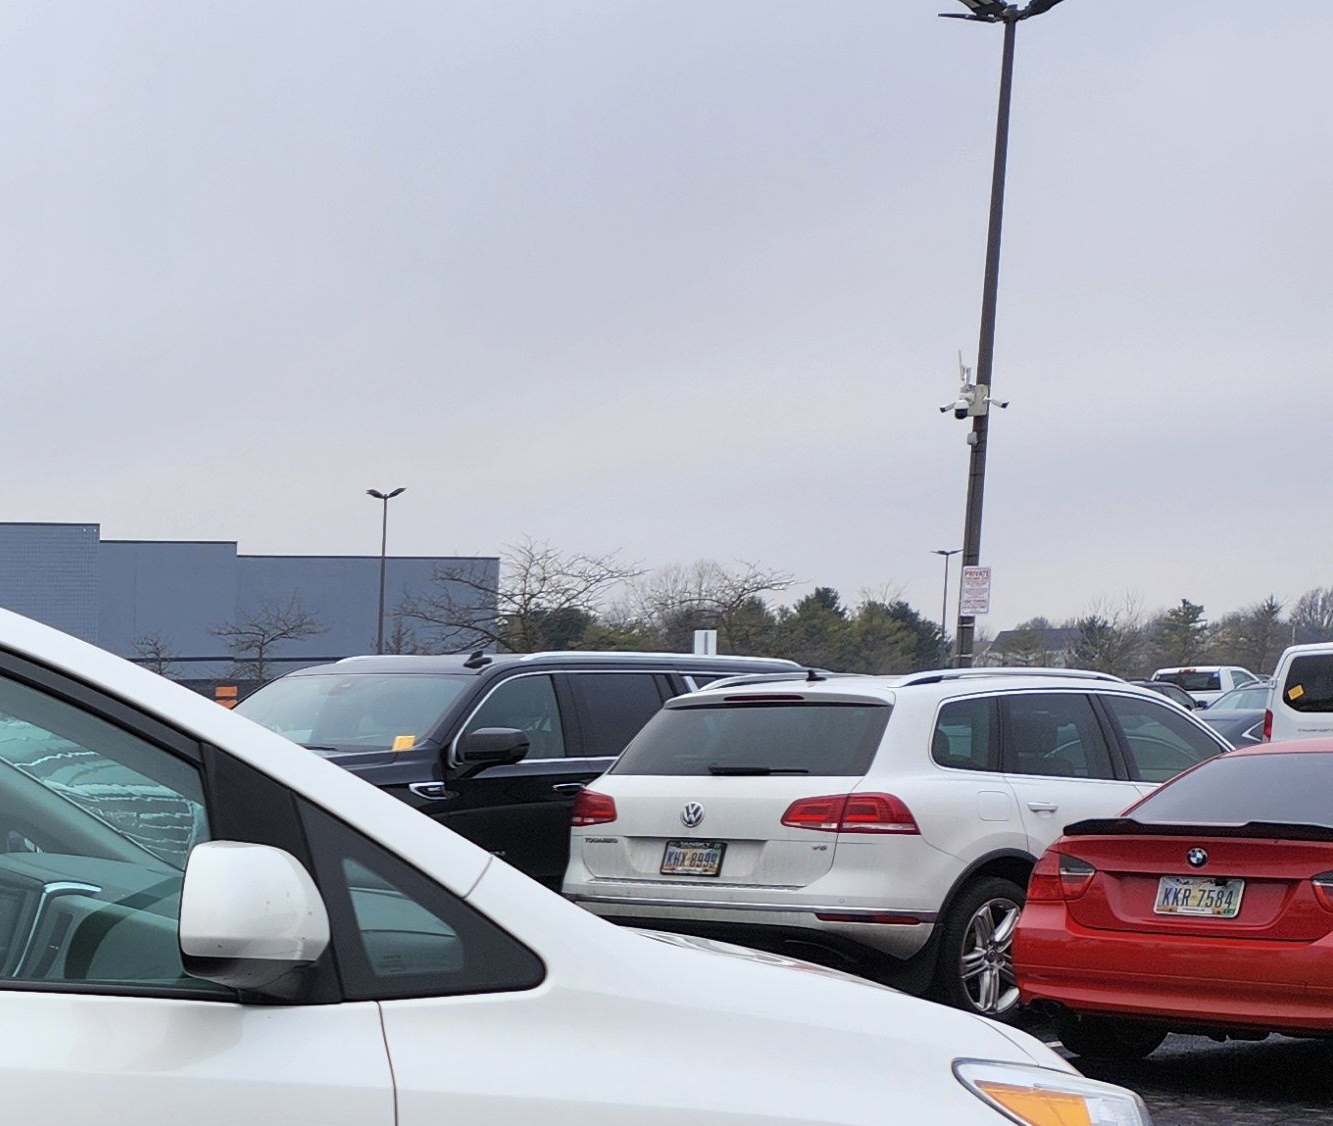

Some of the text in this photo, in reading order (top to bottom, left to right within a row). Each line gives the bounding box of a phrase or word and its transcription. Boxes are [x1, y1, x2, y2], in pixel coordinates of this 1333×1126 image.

[689, 852, 718, 868] 8999
[1162, 887, 1233, 908] KKR 7584
